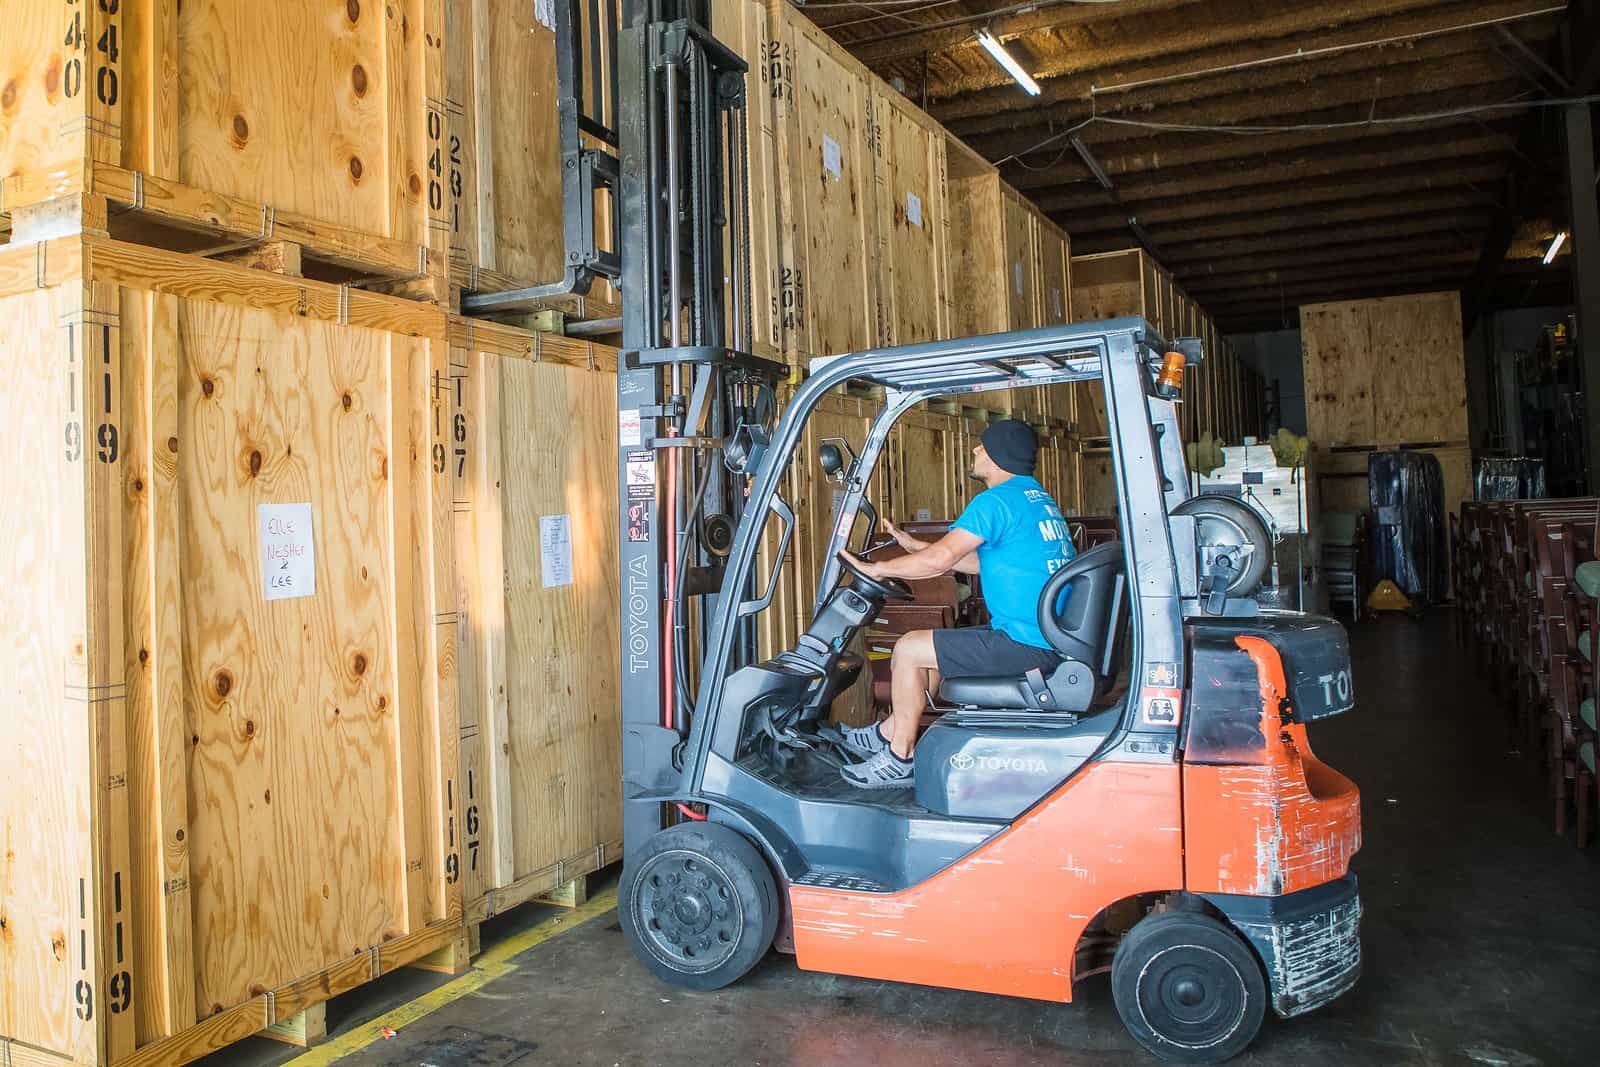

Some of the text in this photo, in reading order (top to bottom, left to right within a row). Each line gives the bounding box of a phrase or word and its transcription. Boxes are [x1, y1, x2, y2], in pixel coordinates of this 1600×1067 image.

[65, 0, 80, 97] 40
[428, 111, 441, 210] 040
[65, 322, 81, 462] 119
[98, 323, 118, 463] 119
[433, 369, 445, 473] 119
[454, 378, 466, 477] 167
[629, 554, 648, 673] TOYOTA
[1319, 670, 1348, 705] TO
[976, 756, 1048, 773] TOYOTA
[447, 780, 458, 884] 119
[467, 770, 479, 870] 167
[76, 878, 92, 1021] 119
[110, 872, 131, 1014] 119
